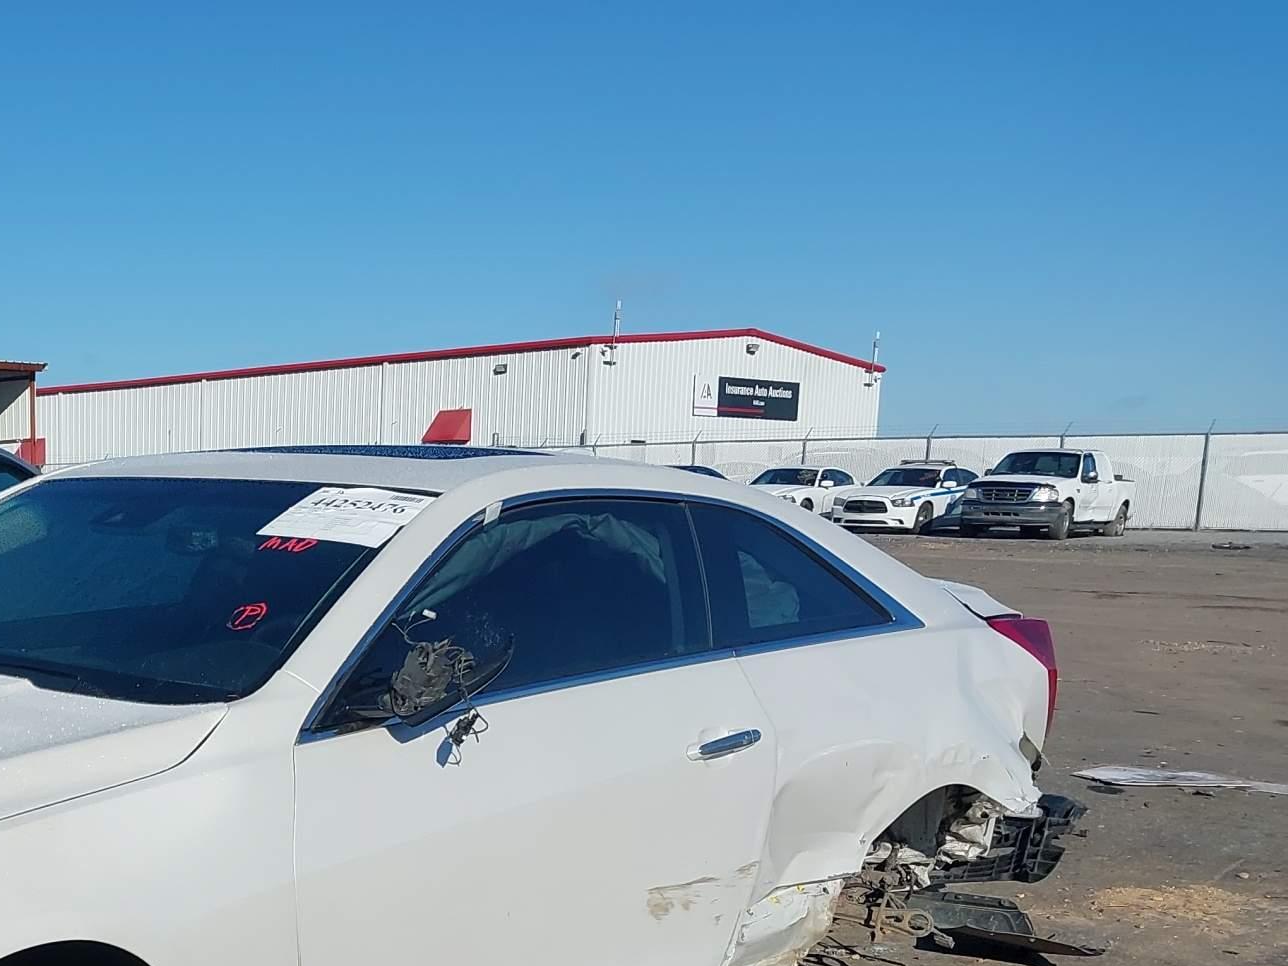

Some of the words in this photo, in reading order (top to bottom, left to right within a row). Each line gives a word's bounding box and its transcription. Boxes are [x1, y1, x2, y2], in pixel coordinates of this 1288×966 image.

[725, 382, 753, 395] Insurance
[754, 384, 767, 397] Auto
[768, 386, 792, 399] Auctions
[310, 497, 408, 514] 44252476
